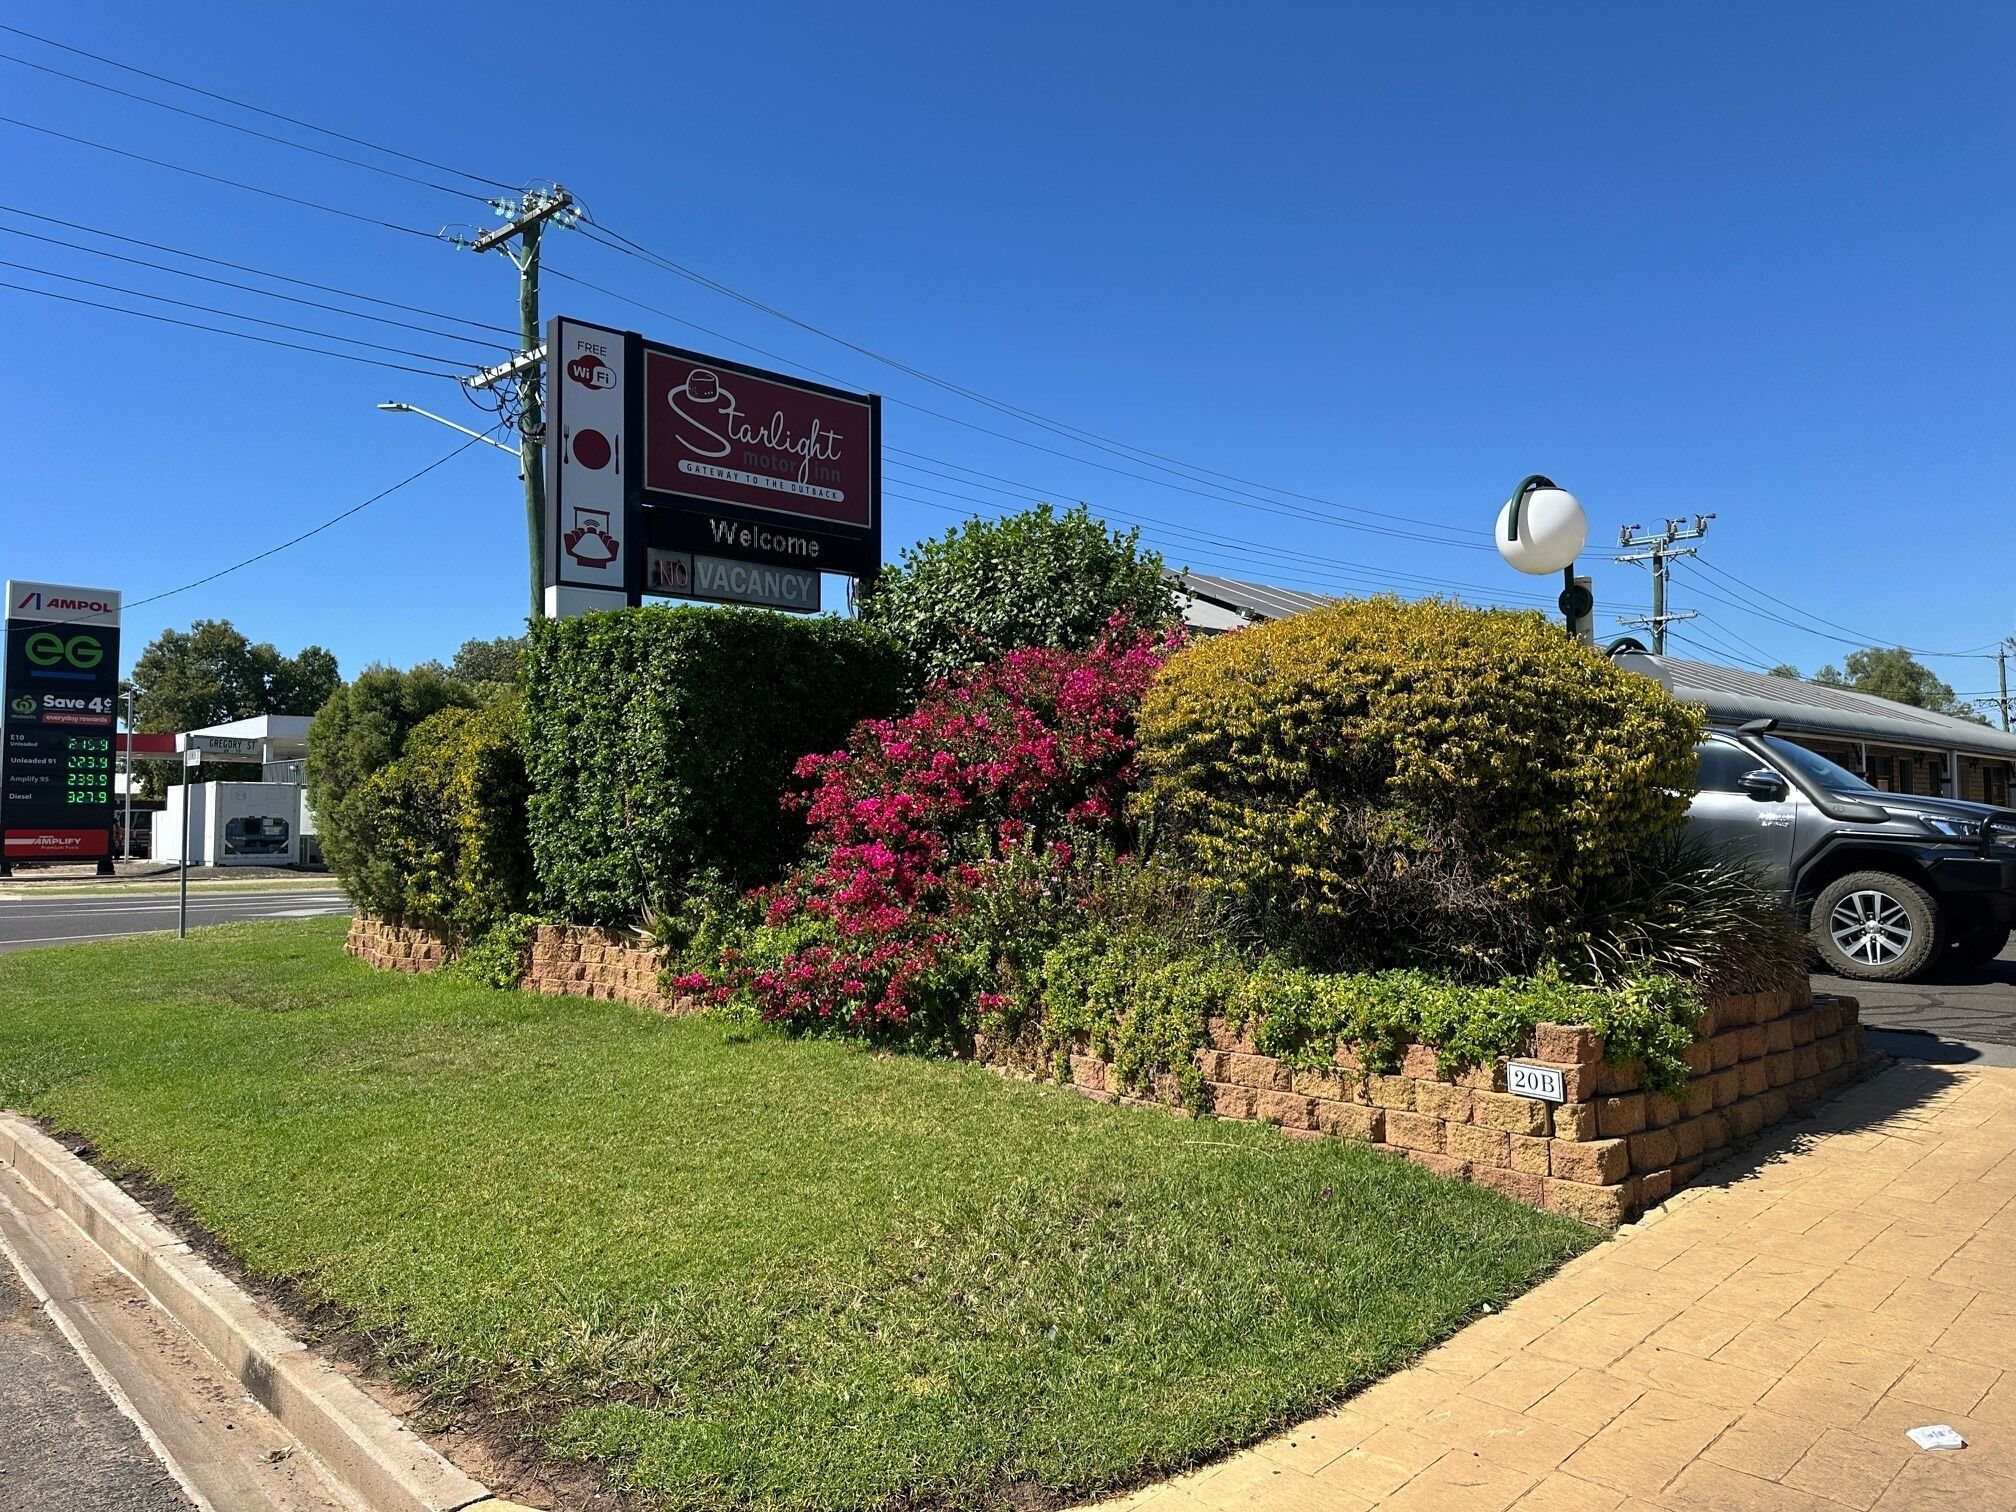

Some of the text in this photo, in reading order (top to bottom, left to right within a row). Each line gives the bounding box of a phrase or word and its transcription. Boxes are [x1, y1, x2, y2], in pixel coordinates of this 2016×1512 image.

[577, 340, 607, 357] FREE
[667, 380, 844, 485] Starlight
[743, 451, 841, 483] motor inn
[686, 462, 839, 500] GATEWAY TO THE OUTBACK
[709, 518, 820, 558] Welcome
[659, 559, 813, 602] NO VACANCY
[46, 598, 112, 613] AMPOL
[43, 694, 85, 709] Save
[46, 715, 79, 723] everyday
[209, 738, 256, 750] GREGORY ST
[67, 791, 107, 804] 327.9
[1514, 1069, 1555, 1093] 20B
